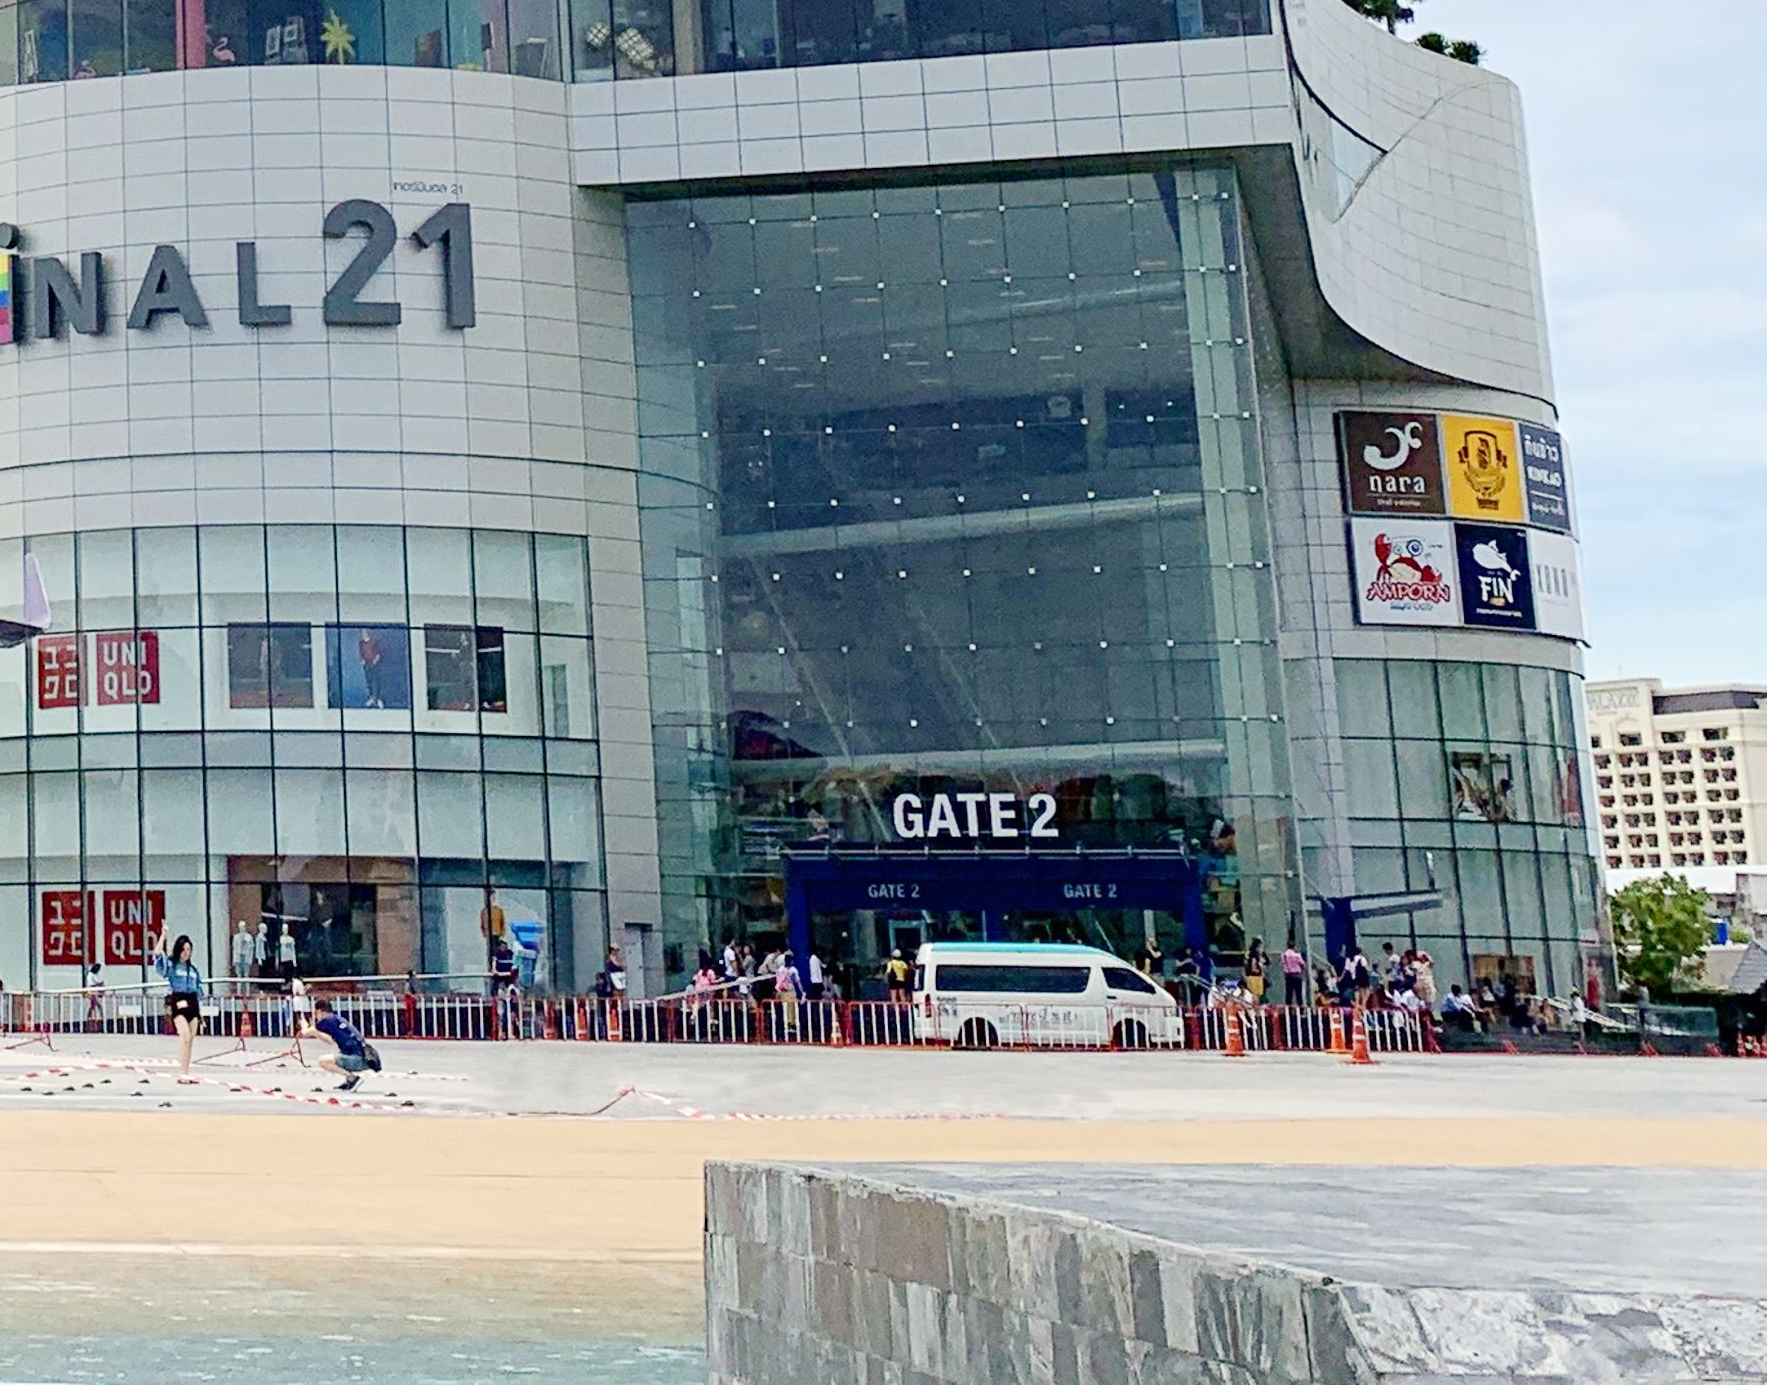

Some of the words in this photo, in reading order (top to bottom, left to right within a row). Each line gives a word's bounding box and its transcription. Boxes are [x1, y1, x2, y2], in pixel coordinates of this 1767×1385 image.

[450, 183, 463, 194] 21
[323, 198, 476, 329] 21
[1369, 475, 1425, 493] nara
[1366, 582, 1450, 604] AMPORN
[1477, 575, 1514, 604] FIN
[103, 641, 146, 666] UNI
[893, 793, 1019, 838] GATE
[1028, 793, 1059, 838] 2
[868, 884, 905, 898] GATE
[911, 883, 920, 898] 2
[1063, 883, 1102, 898] GATE
[1107, 883, 1117, 898] 2
[111, 899, 153, 925] UNI
